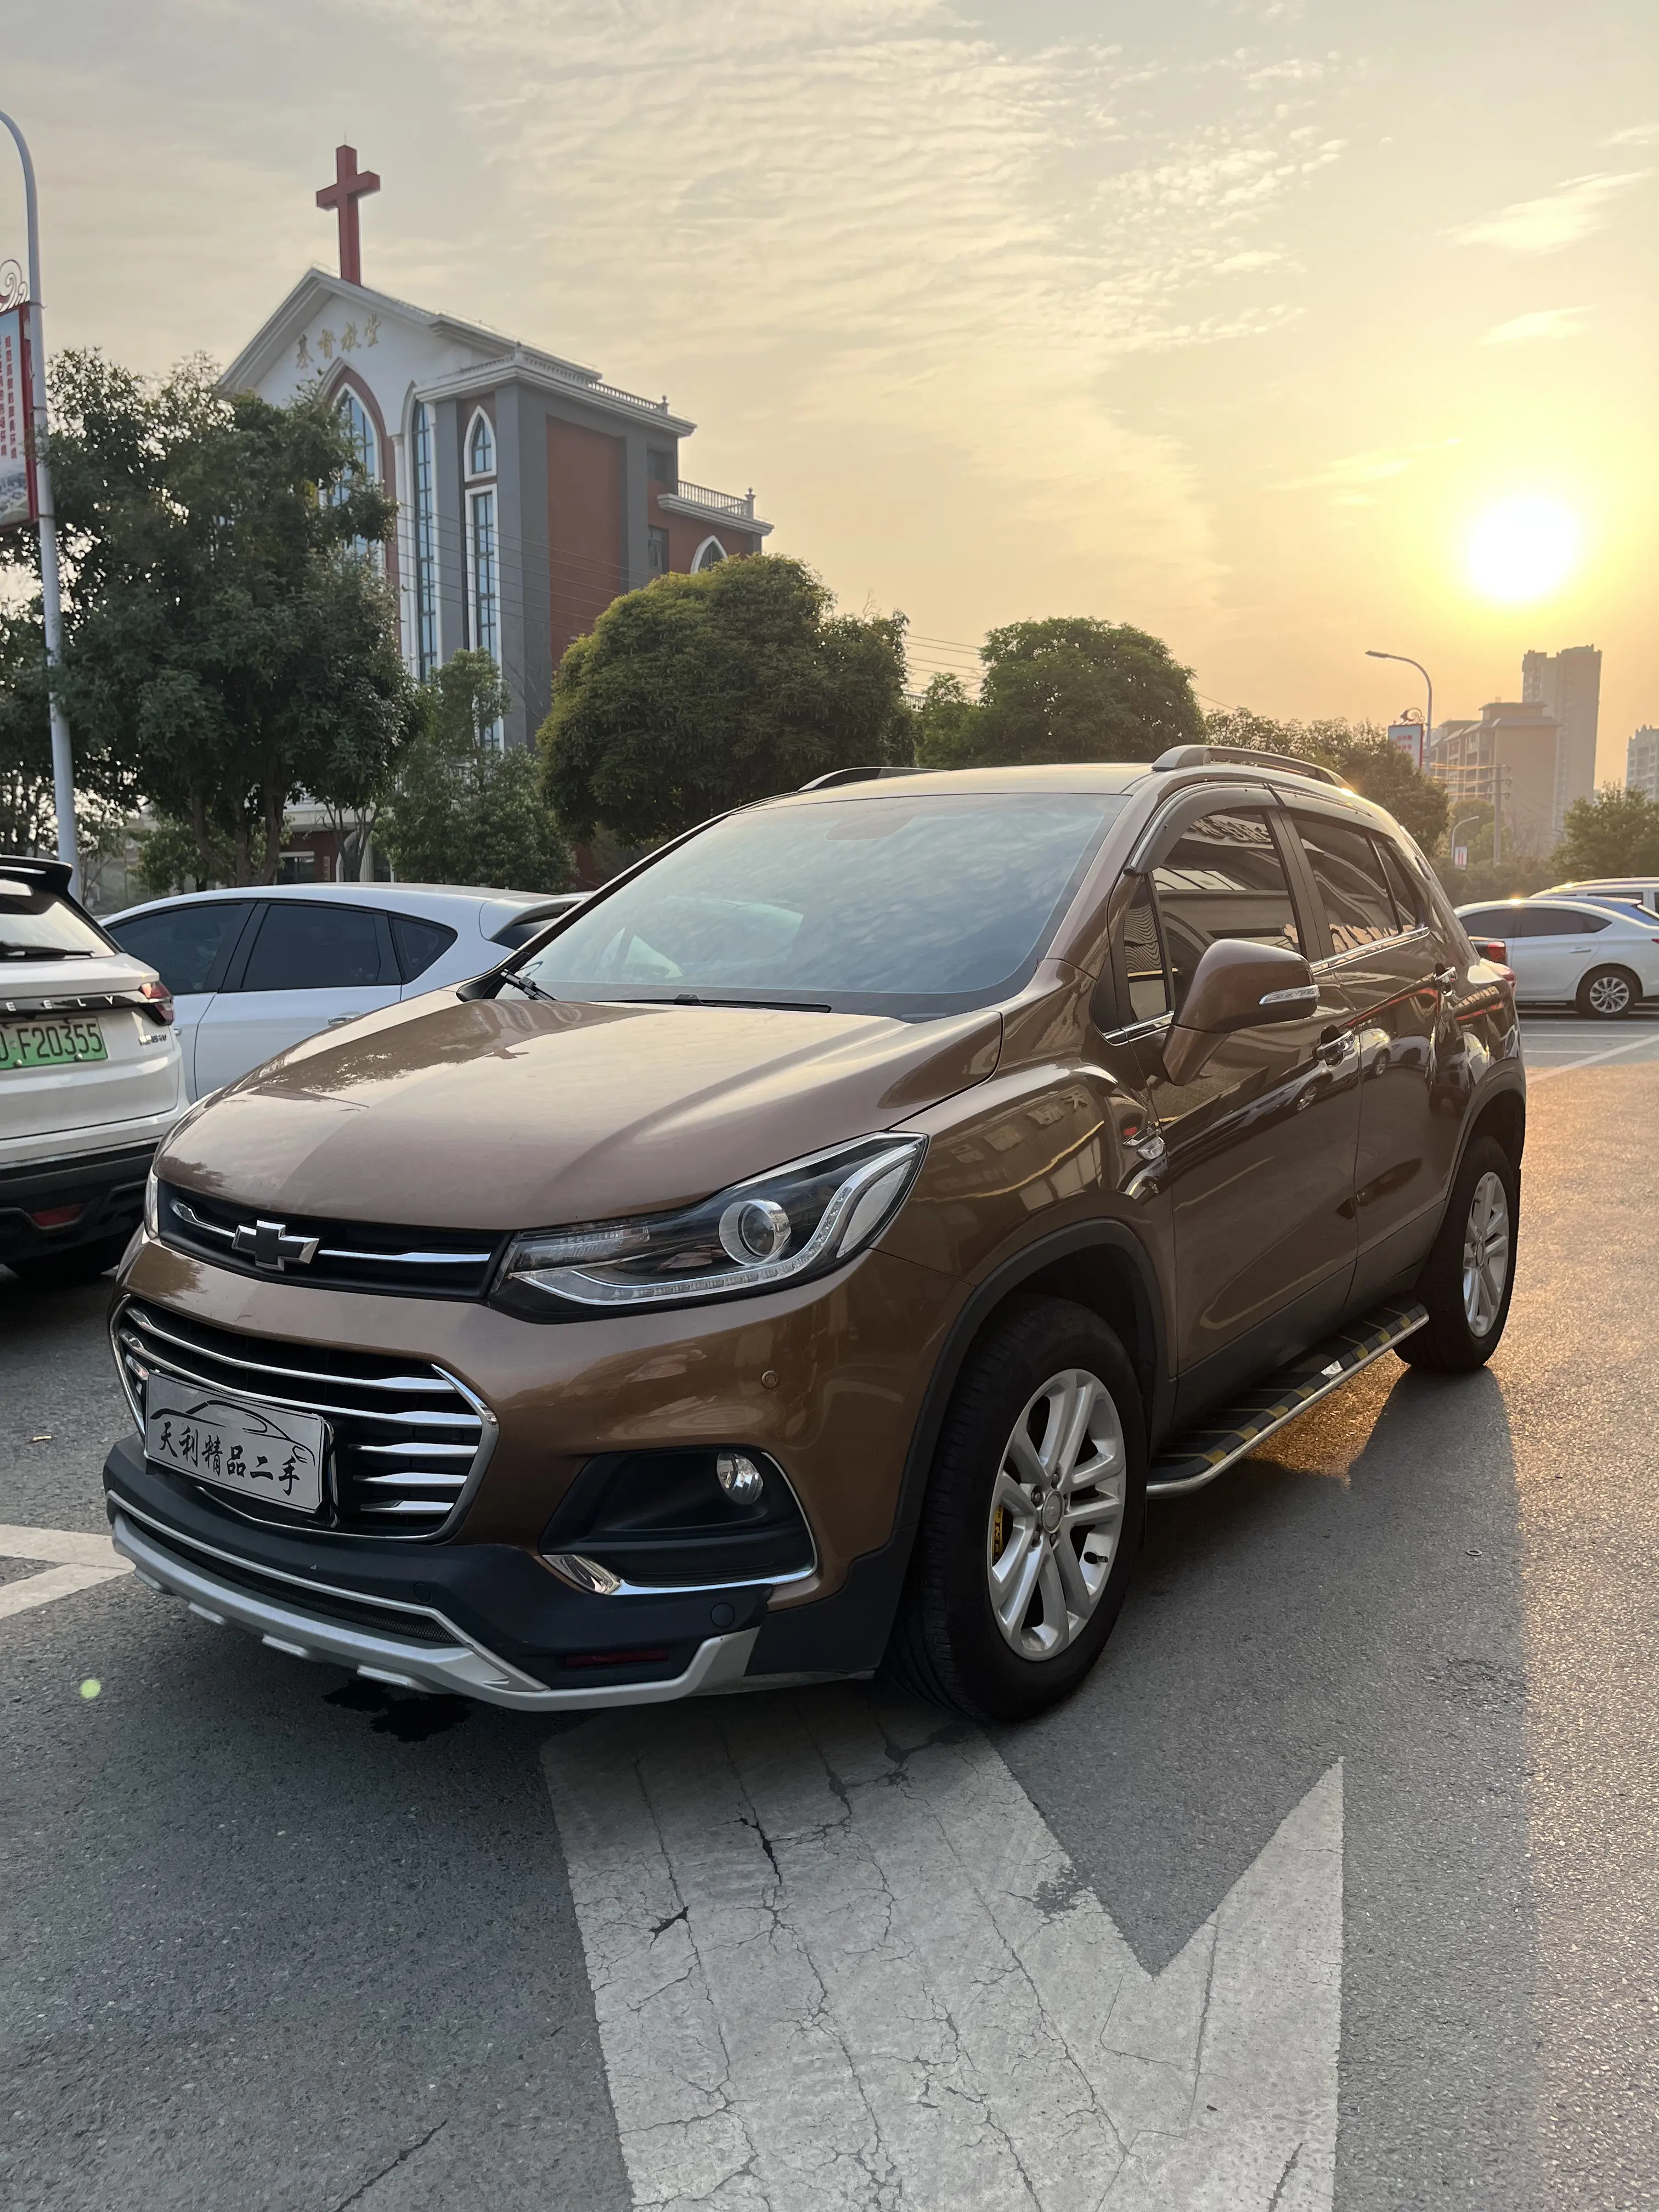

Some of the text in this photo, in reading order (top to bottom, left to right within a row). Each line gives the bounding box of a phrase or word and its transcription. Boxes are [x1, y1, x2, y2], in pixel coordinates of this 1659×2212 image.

[160, 1421, 300, 1496] 天利精品二手
